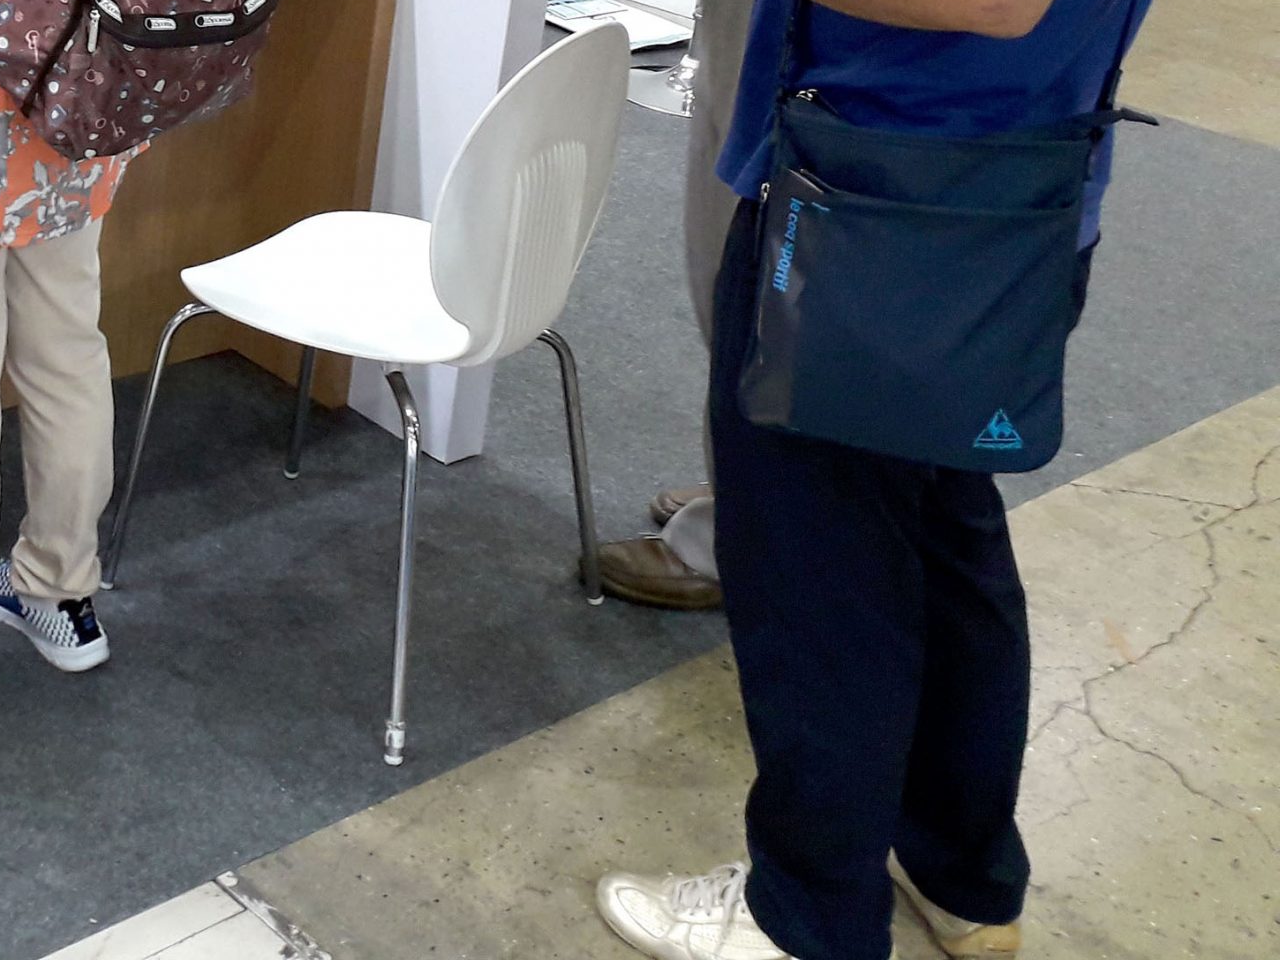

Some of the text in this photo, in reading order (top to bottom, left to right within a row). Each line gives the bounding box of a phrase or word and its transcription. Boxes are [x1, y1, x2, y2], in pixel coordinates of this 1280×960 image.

[772, 197, 805, 293] le coq sportif
